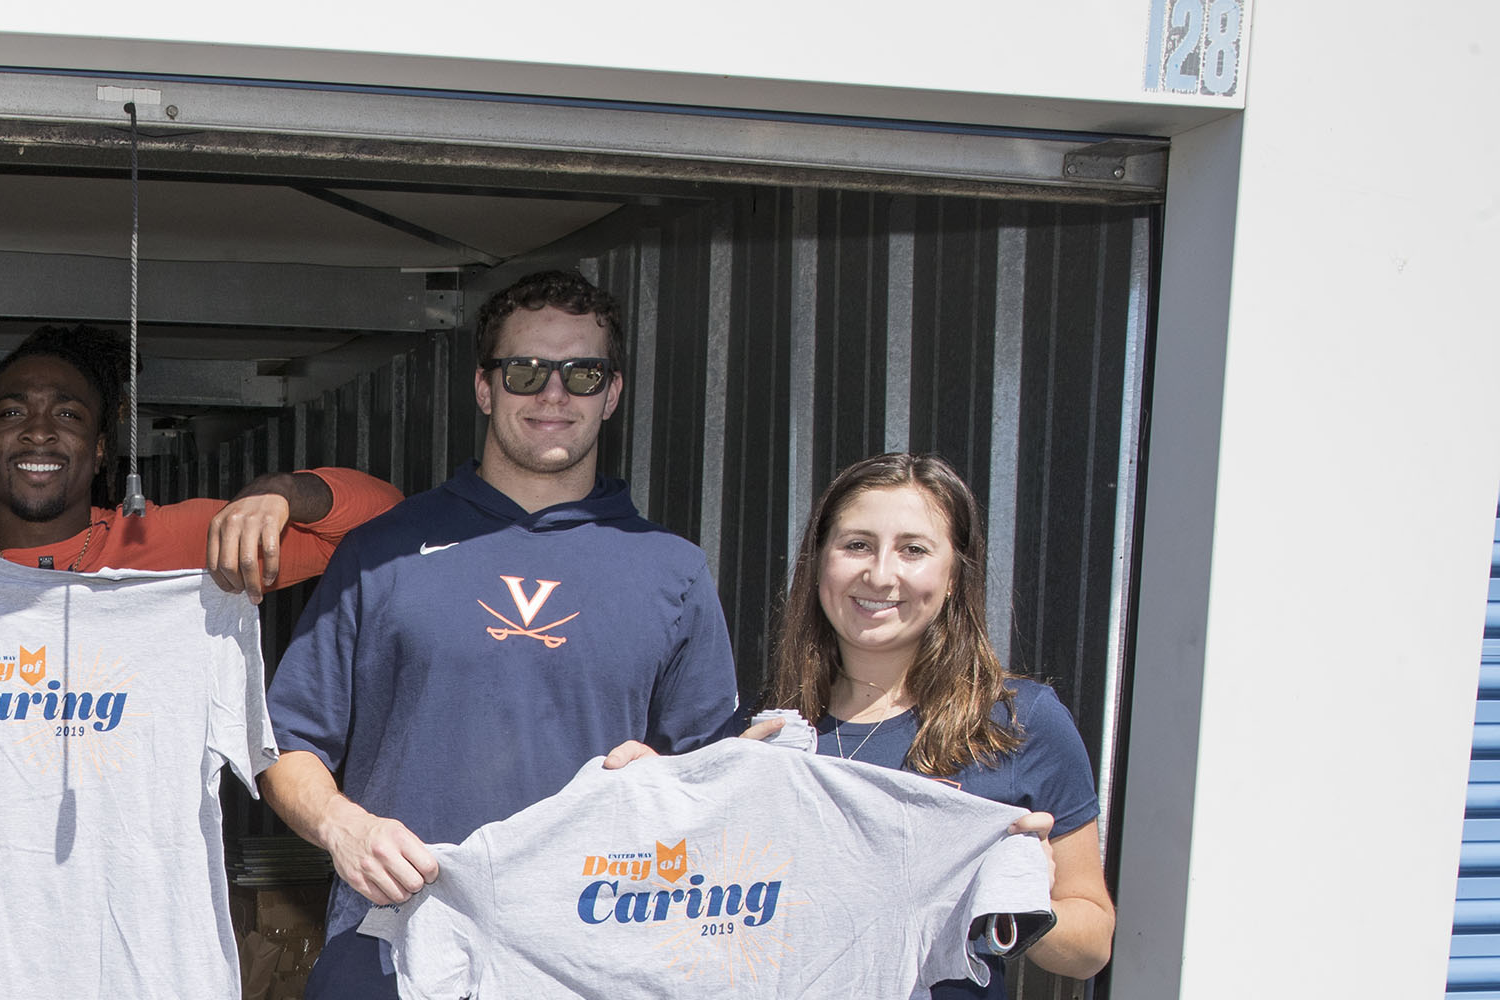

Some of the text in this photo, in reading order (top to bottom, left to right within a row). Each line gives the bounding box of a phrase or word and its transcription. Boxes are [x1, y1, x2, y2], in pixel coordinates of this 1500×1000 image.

[500, 575, 561, 628] V
[21, 660, 43, 675] of
[55, 726, 85, 737] 2019
[582, 855, 683, 881] Day of
[577, 874, 782, 927] Caring
[701, 922, 735, 936] 2019
